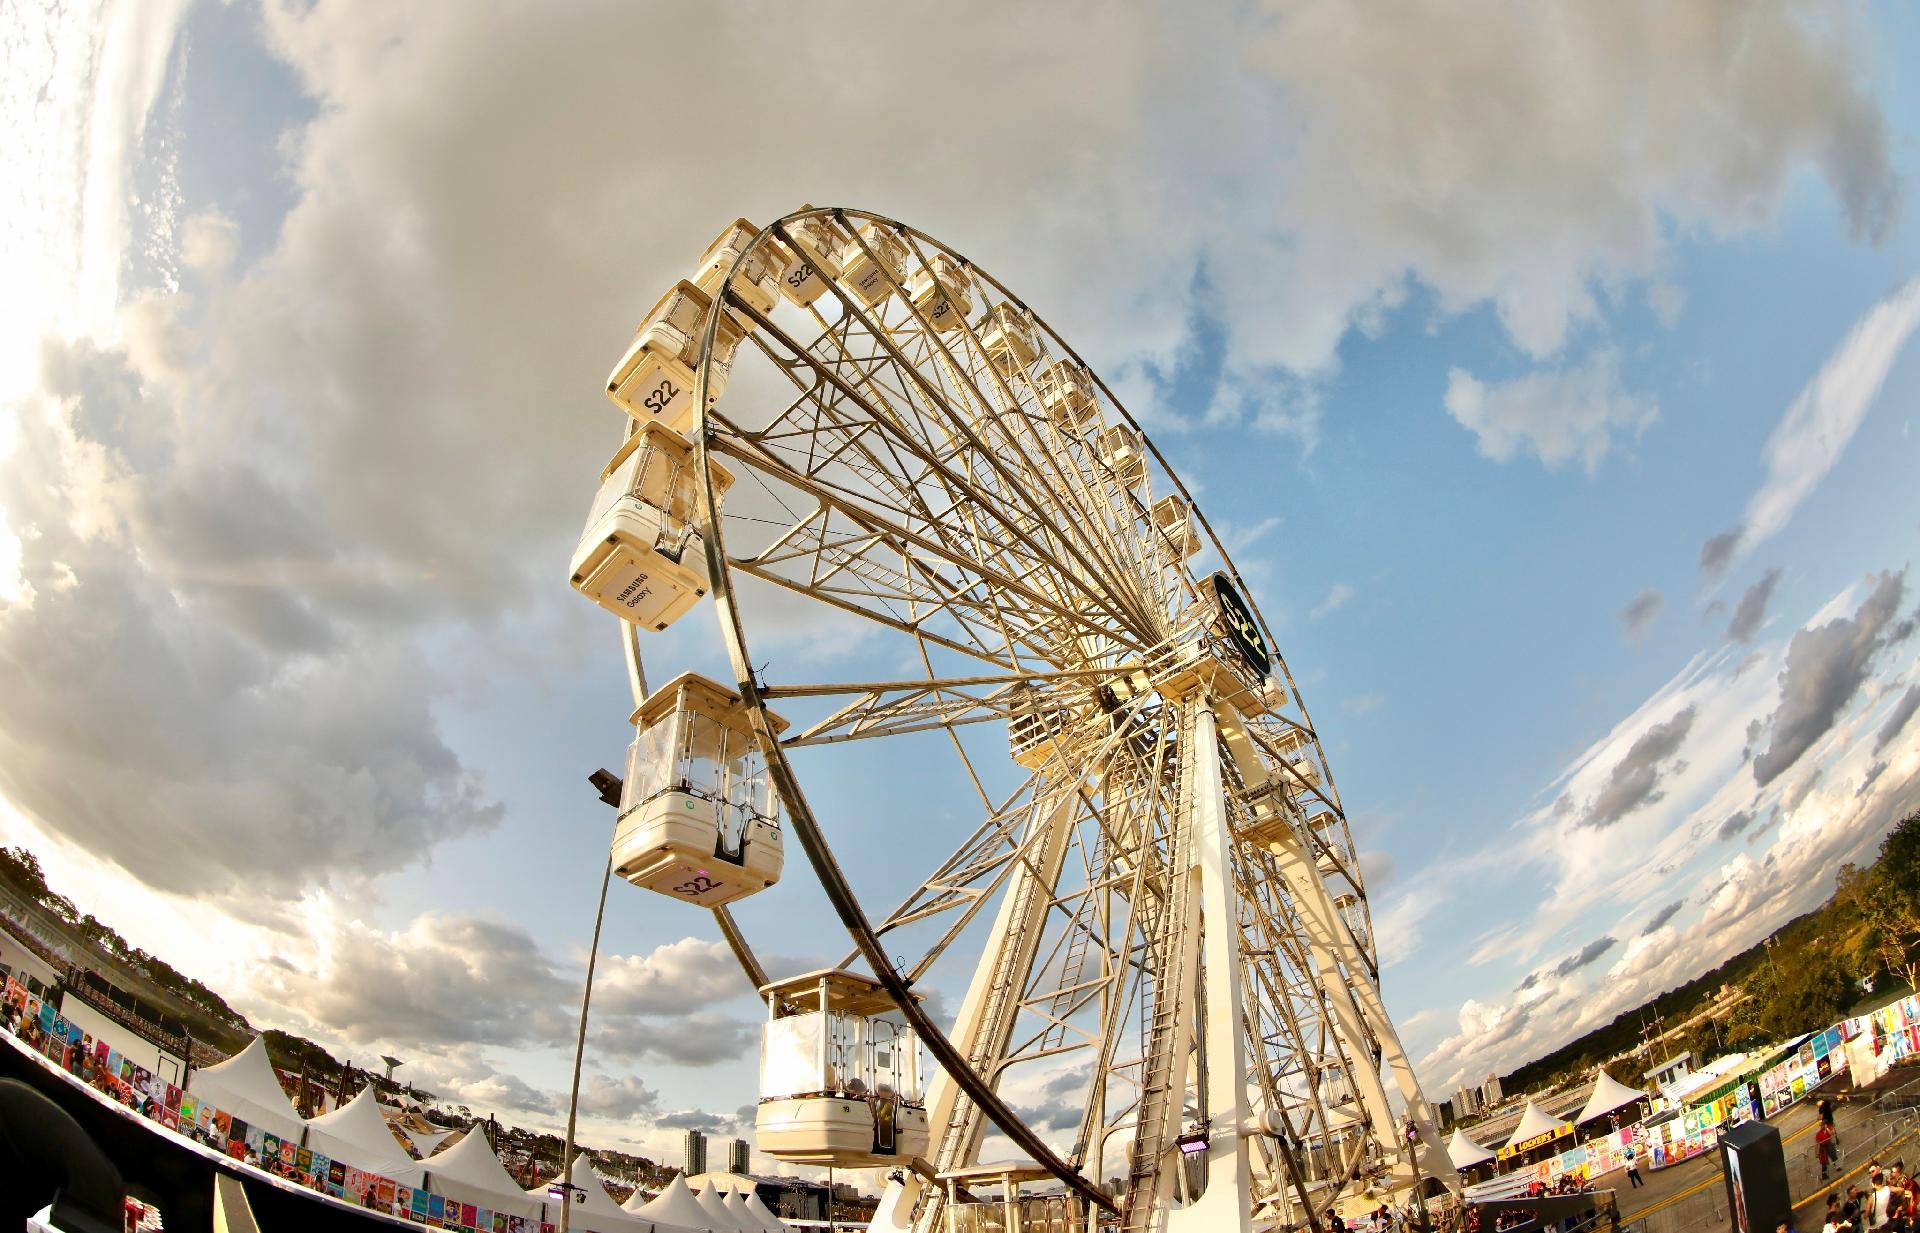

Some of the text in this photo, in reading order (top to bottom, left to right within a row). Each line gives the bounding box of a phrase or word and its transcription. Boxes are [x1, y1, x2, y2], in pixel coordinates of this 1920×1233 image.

[787, 264, 814, 288] S22
[643, 379, 681, 414] S22
[616, 573, 649, 602] SAMSUNG
[672, 876, 724, 896] S22
[1519, 1132, 1552, 1150] LOCKERS
